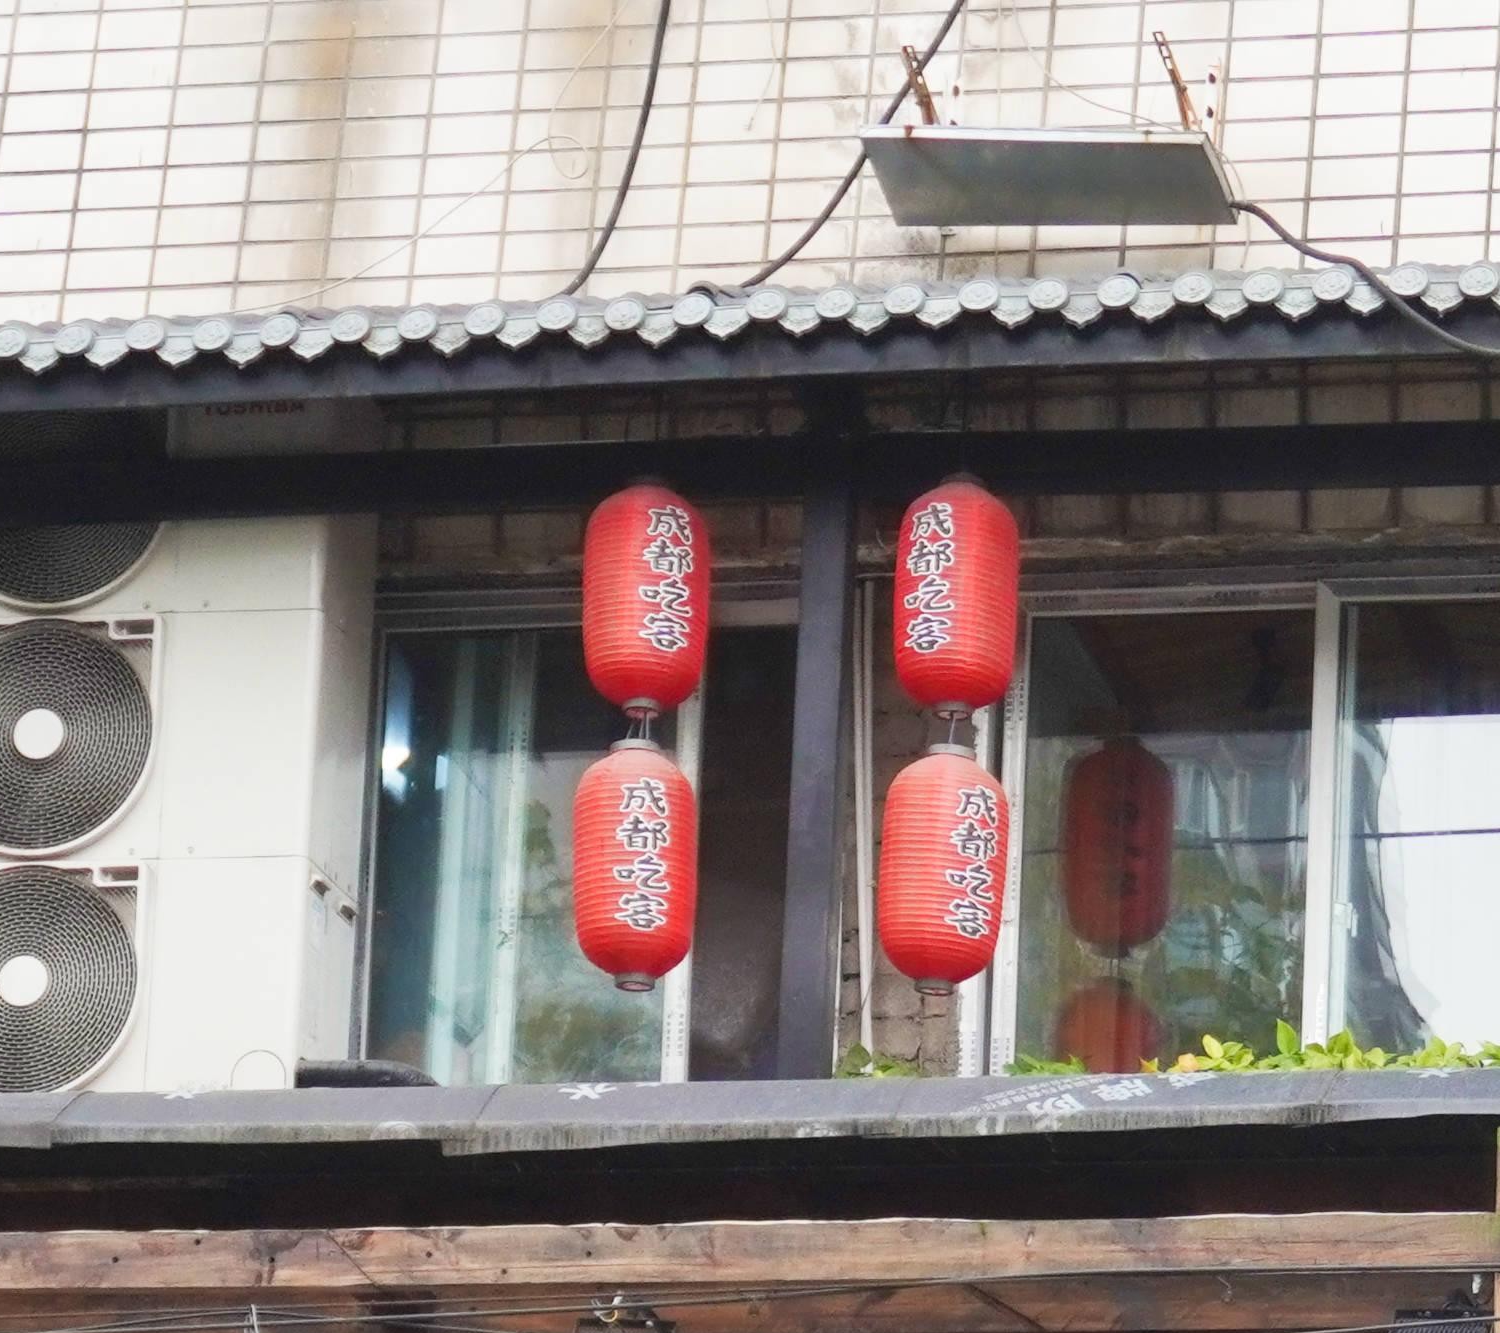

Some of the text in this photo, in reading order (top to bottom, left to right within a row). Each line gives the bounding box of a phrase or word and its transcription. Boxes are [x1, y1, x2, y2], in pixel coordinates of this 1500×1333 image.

[638, 506, 693, 652] 成都吃客
[905, 502, 955, 653] 成都吃客
[613, 777, 671, 931] 成都吃客
[944, 785, 998, 938] 成都吃客
